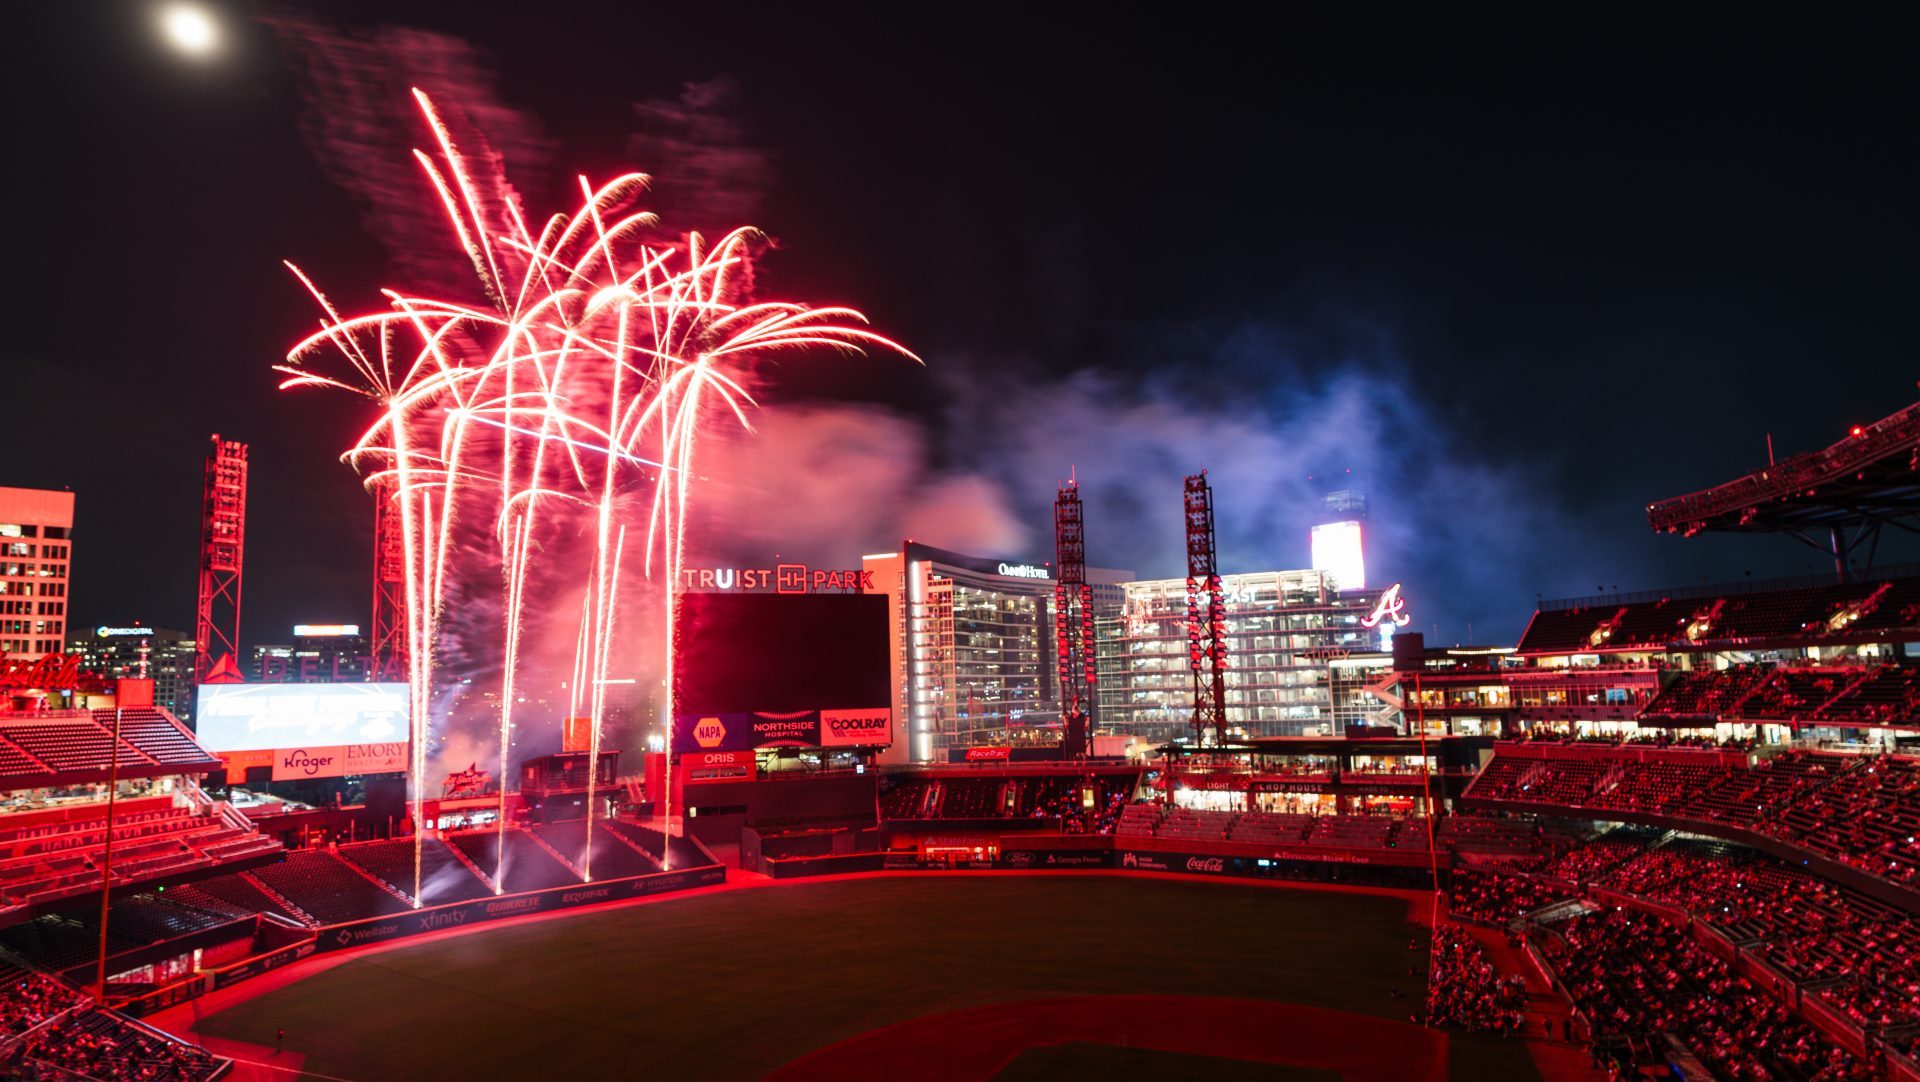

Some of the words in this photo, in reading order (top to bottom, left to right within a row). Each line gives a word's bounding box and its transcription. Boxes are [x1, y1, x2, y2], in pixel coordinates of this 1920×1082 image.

[683, 569, 771, 589] TRUIST
[813, 571, 875, 589] PARK
[1304, 646, 1350, 660] xfinity
[262, 655, 401, 680] DELTA
[753, 721, 815, 732] NORTHSIDE
[831, 718, 887, 730] COOLRAY
[698, 726, 721, 740] NAPA
[348, 743, 405, 759] EMORY
[704, 753, 735, 764] ORIS
[284, 750, 333, 775] Kroger
[1207, 782, 1229, 790] LIGHT
[1259, 784, 1285, 792] CHOP
[1289, 784, 1323, 792] HOUSE
[562, 888, 609, 903] EQUIFAX
[486, 896, 541, 914] QUIKRETE
[420, 909, 468, 929] xfinity
[354, 924, 398, 940] Wellstar
